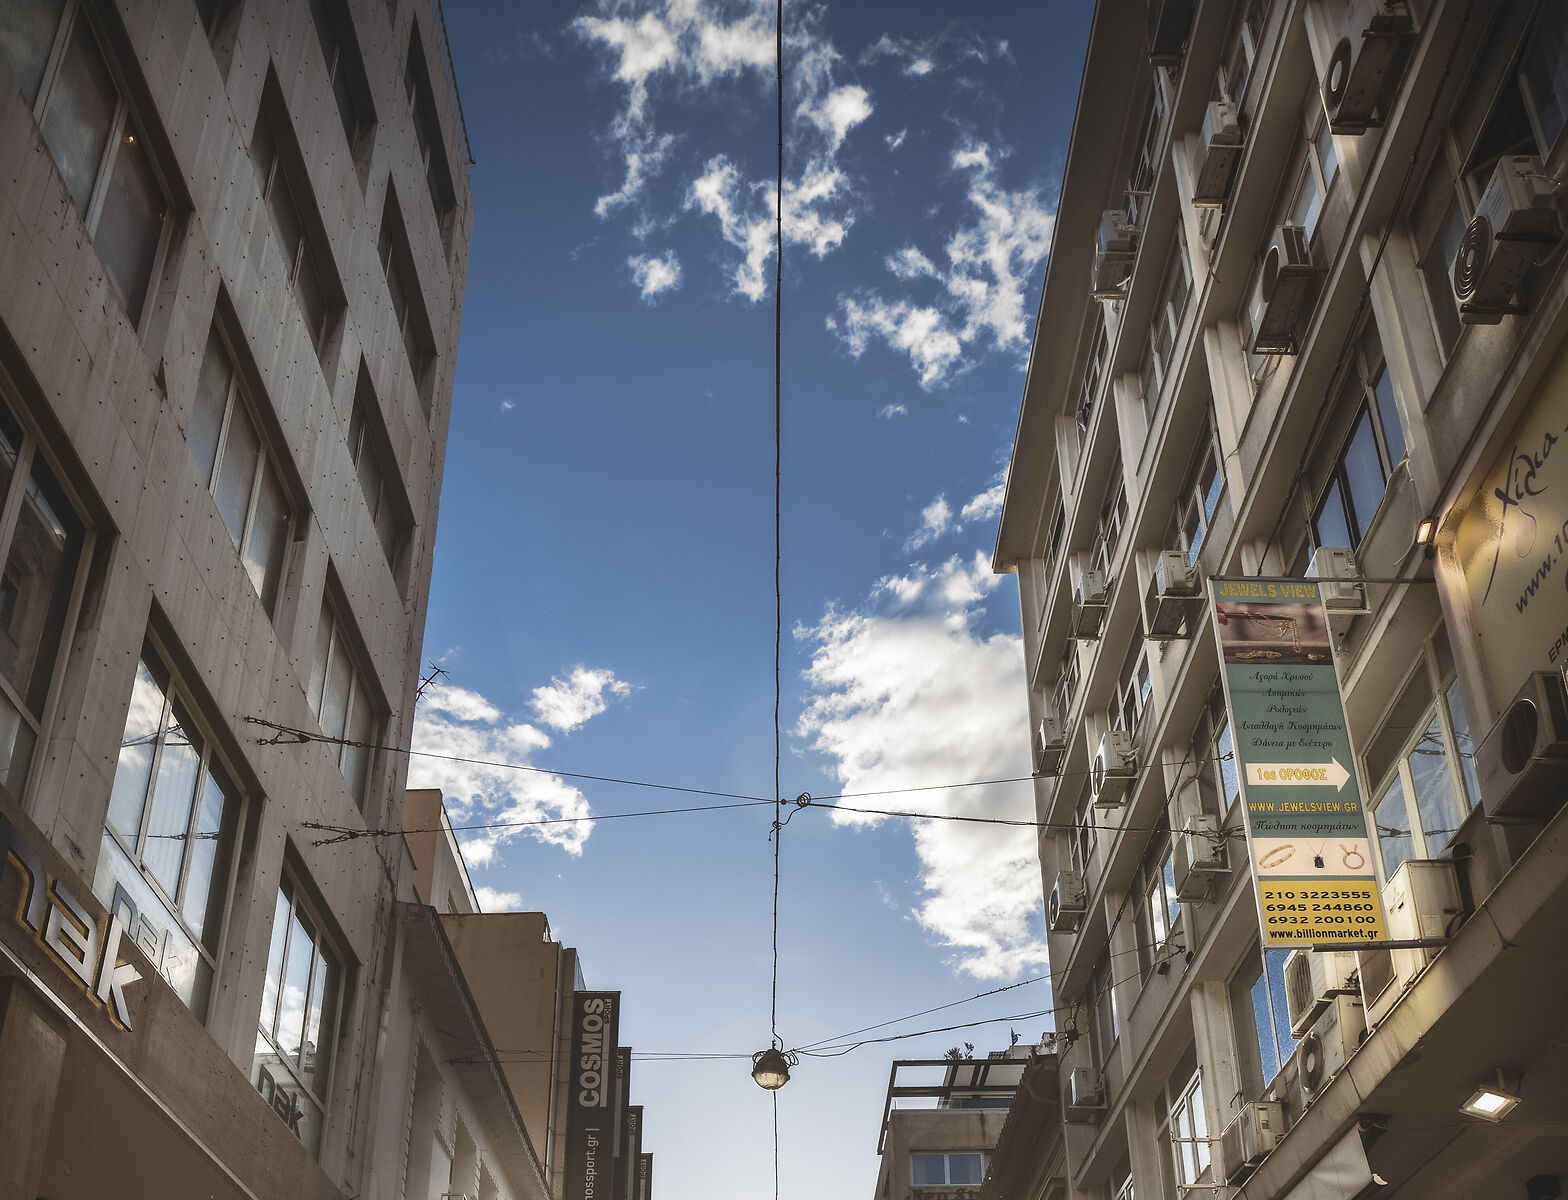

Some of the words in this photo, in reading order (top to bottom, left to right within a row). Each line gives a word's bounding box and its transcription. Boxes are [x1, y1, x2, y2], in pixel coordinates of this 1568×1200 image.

[1219, 583, 1277, 598] JEWELS
[1279, 583, 1317, 598] VIEW
[1286, 740, 1296, 750] με
[1278, 767, 1328, 781] ΟΡΟΦΟΣ
[1248, 802, 1358, 813] WWW.JEWELSVIEW.GR
[1265, 891, 1295, 899] 210
[1300, 891, 1371, 899] 3223555
[1266, 903, 1307, 912] 6945
[1312, 903, 1374, 912] 244860
[1268, 916, 1309, 924] 6932
[1314, 916, 1376, 924] 200100
[1269, 928, 1379, 940] www.billionmarket.gr
[604, 998, 613, 1025] SPORT
[578, 998, 605, 1108] COSMOS
[258, 1063, 305, 1140] nak
